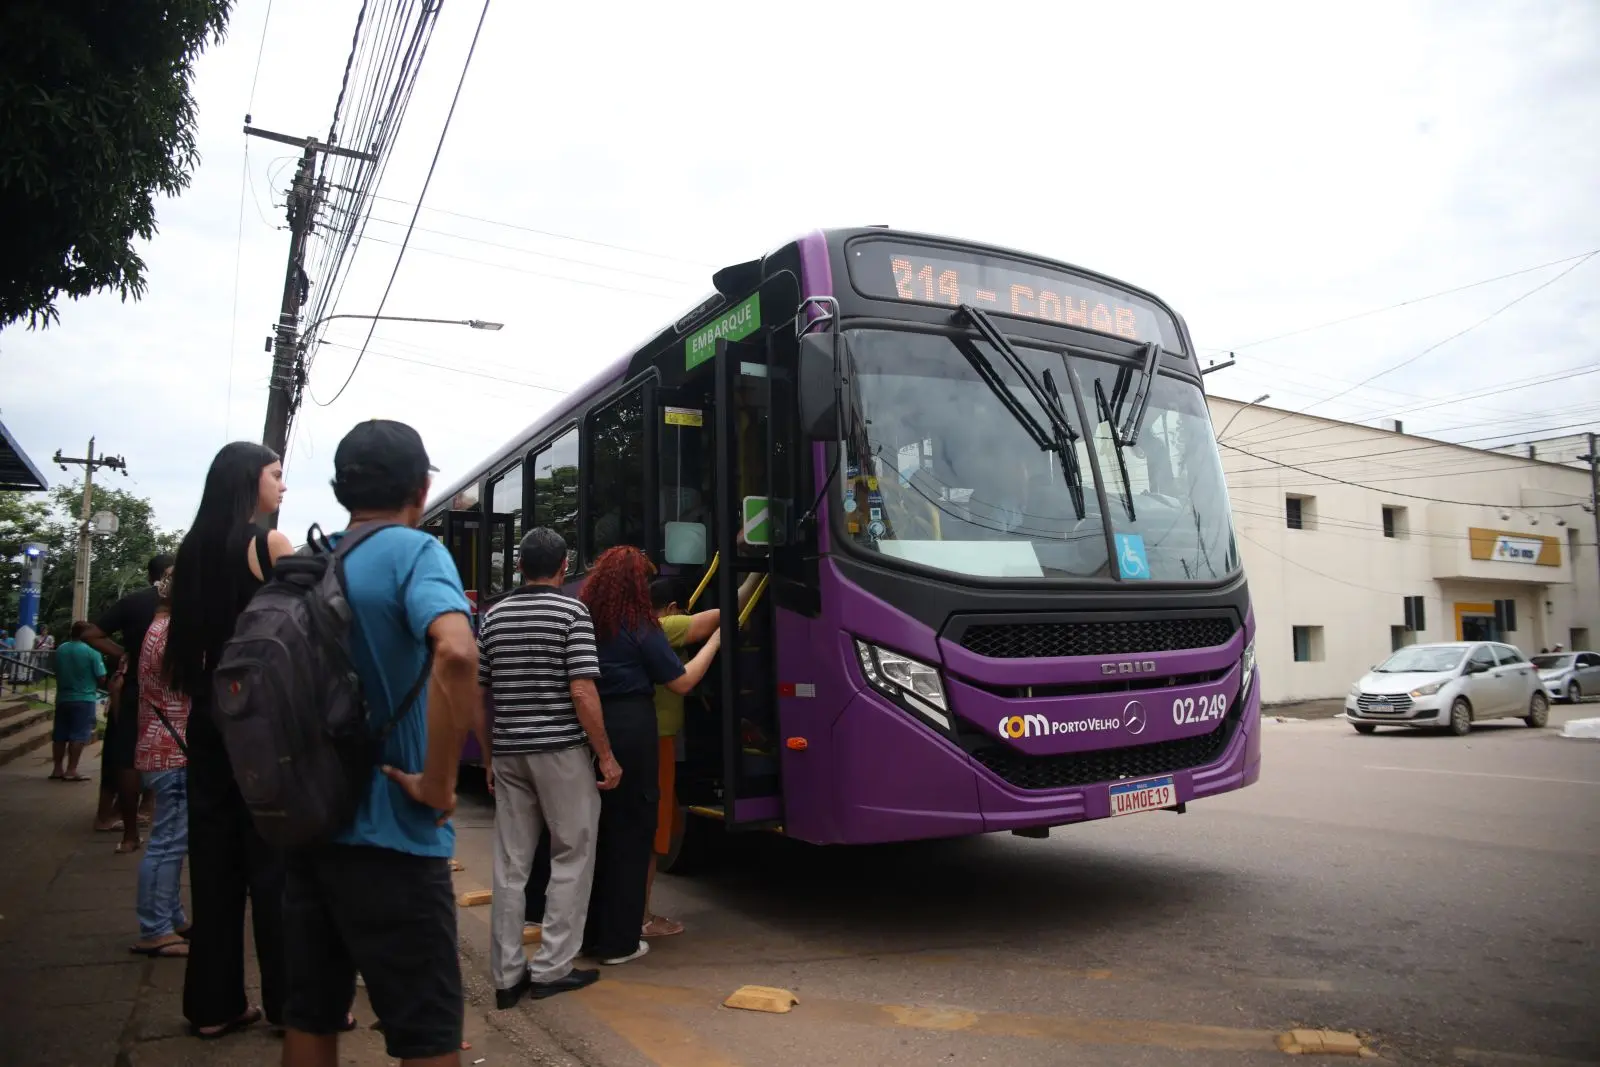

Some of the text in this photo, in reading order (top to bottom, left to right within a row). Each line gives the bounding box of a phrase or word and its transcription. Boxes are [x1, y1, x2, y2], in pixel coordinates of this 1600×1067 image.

[891, 257, 960, 305] 214
[1010, 283, 1137, 338] COHAB
[692, 303, 752, 353] EMBARQUE
[1101, 660, 1156, 675] CAIO
[1173, 693, 1226, 725] 02.249
